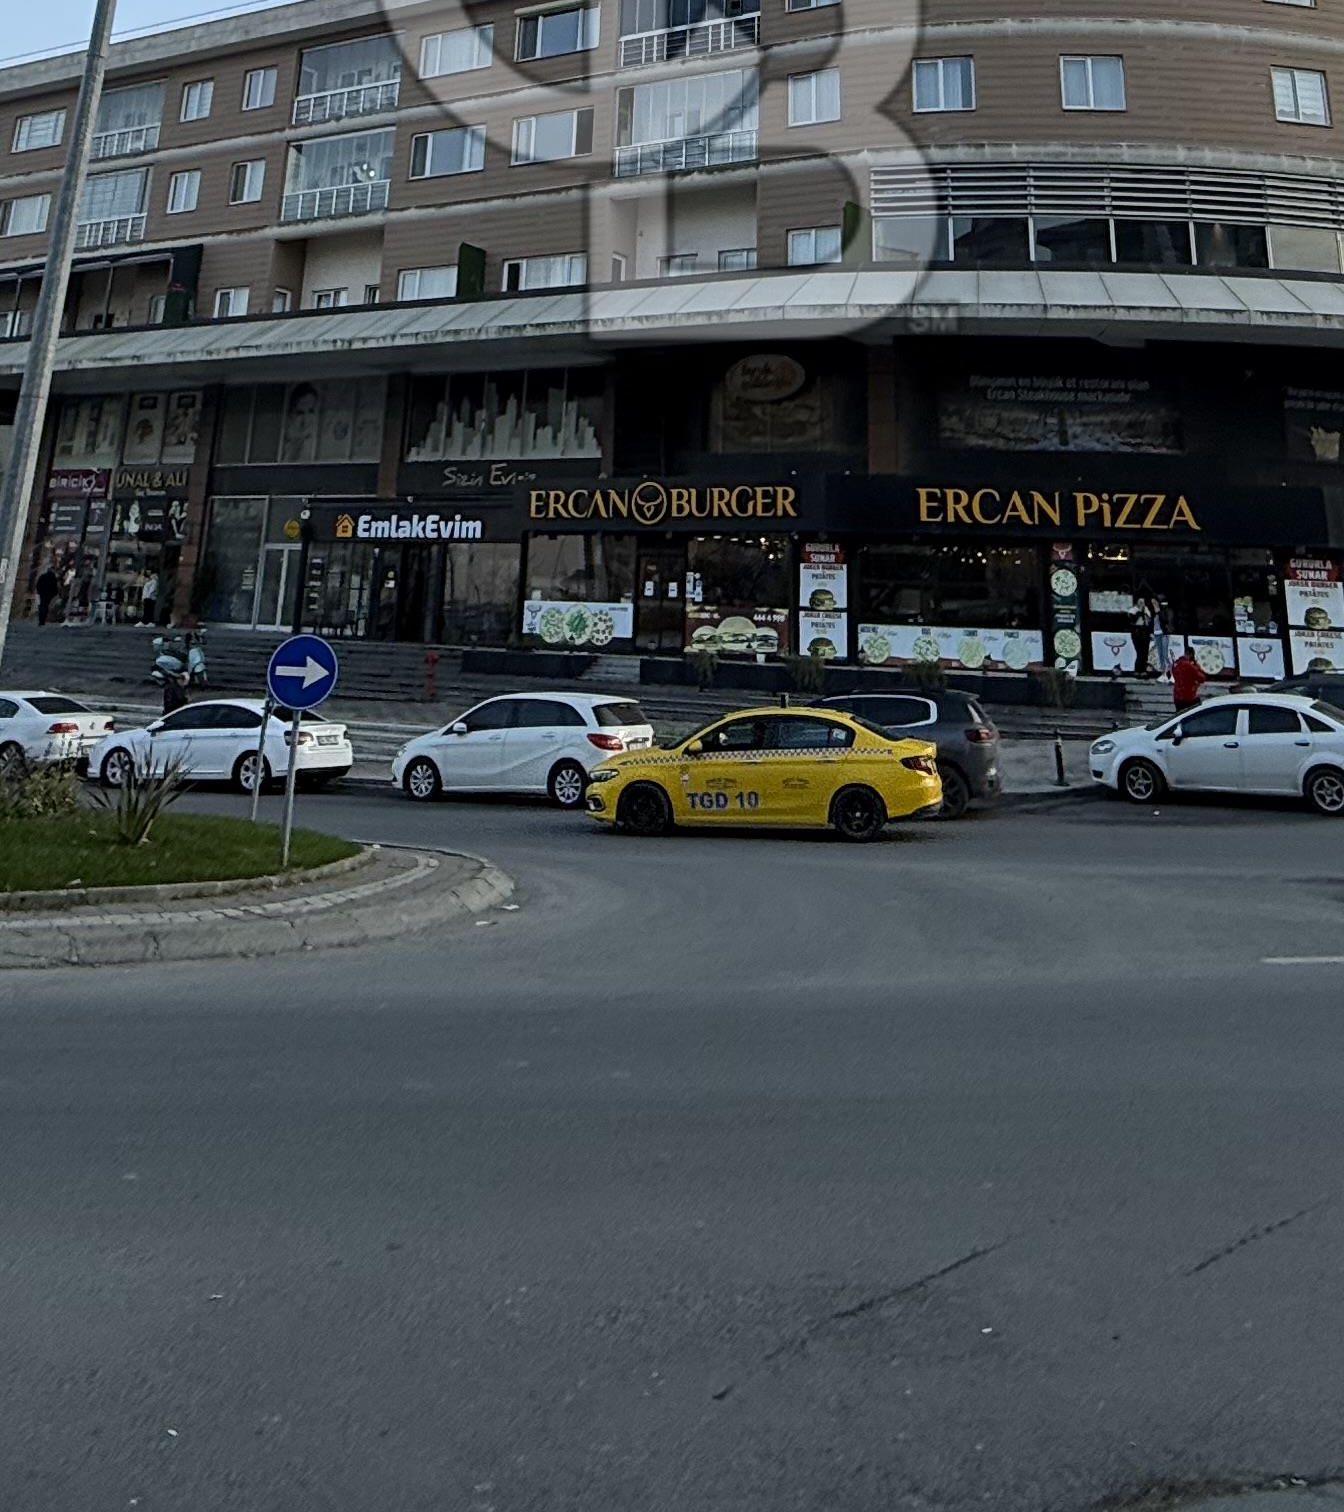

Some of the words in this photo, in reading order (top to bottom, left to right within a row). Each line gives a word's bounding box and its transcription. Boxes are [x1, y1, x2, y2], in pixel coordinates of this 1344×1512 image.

[529, 488, 630, 519] ERCAN
[670, 486, 798, 519] BURGER
[916, 486, 1061, 528] ERCAN
[357, 513, 483, 539] EmlakEvim
[686, 791, 728, 809] TGD
